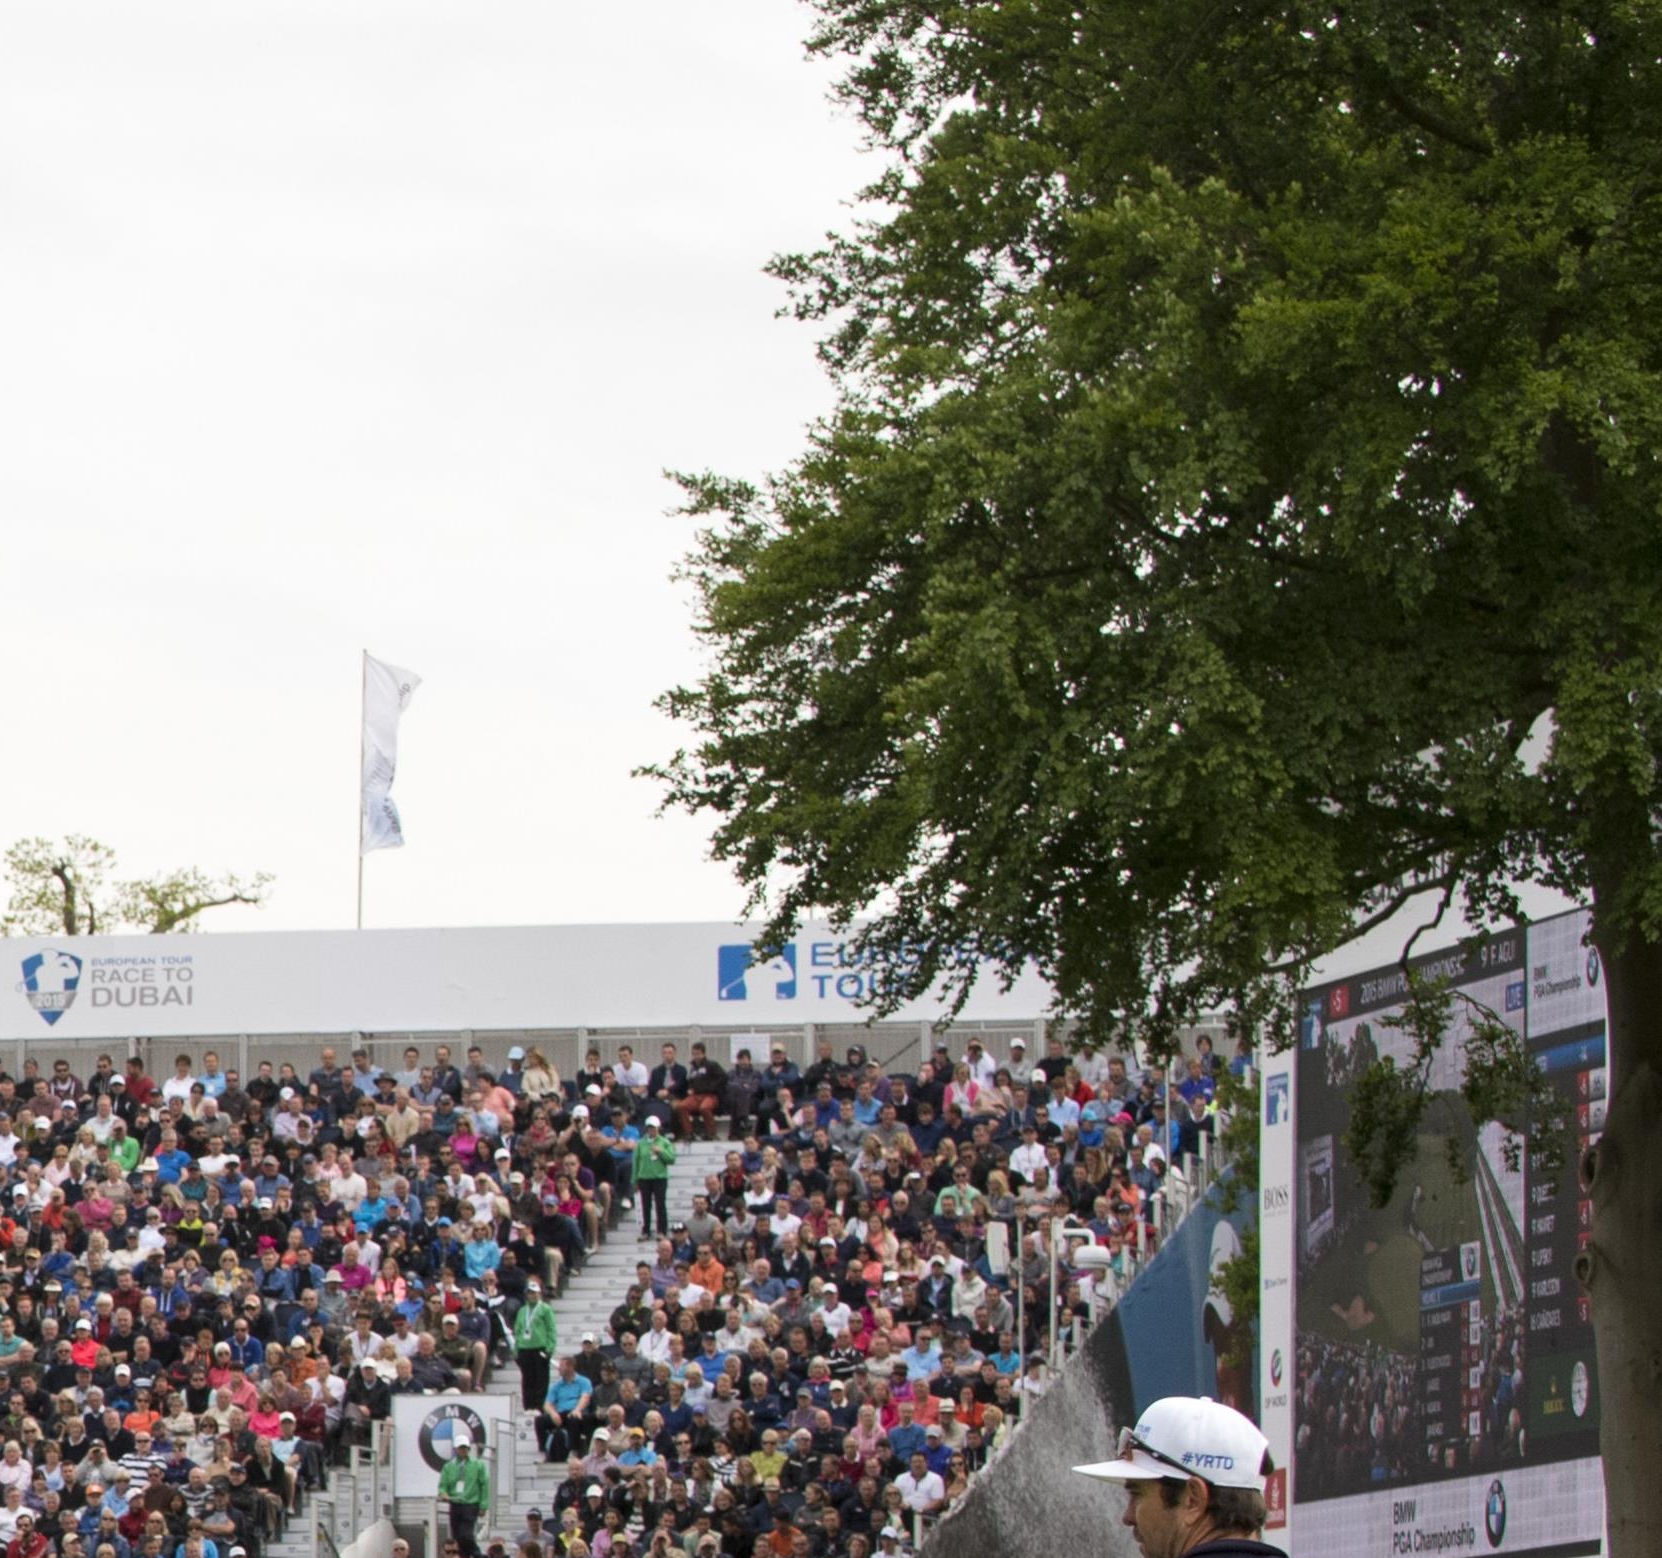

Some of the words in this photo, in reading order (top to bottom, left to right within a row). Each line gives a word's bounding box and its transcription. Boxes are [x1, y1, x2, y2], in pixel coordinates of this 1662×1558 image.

[90, 957, 156, 967] EUROPEAN
[161, 955, 193, 965] TOUR
[90, 967, 155, 984] RACE
[163, 967, 193, 983] TO
[36, 992, 67, 1008] 2015
[90, 986, 193, 1008] DUBAI
[1263, 1186, 1290, 1211] BOSS
[1181, 1451, 1234, 1471] #YRTD
[1393, 1500, 1416, 1525] BMW
[1393, 1530, 1412, 1555] PGA
[1414, 1520, 1475, 1554] Championship
